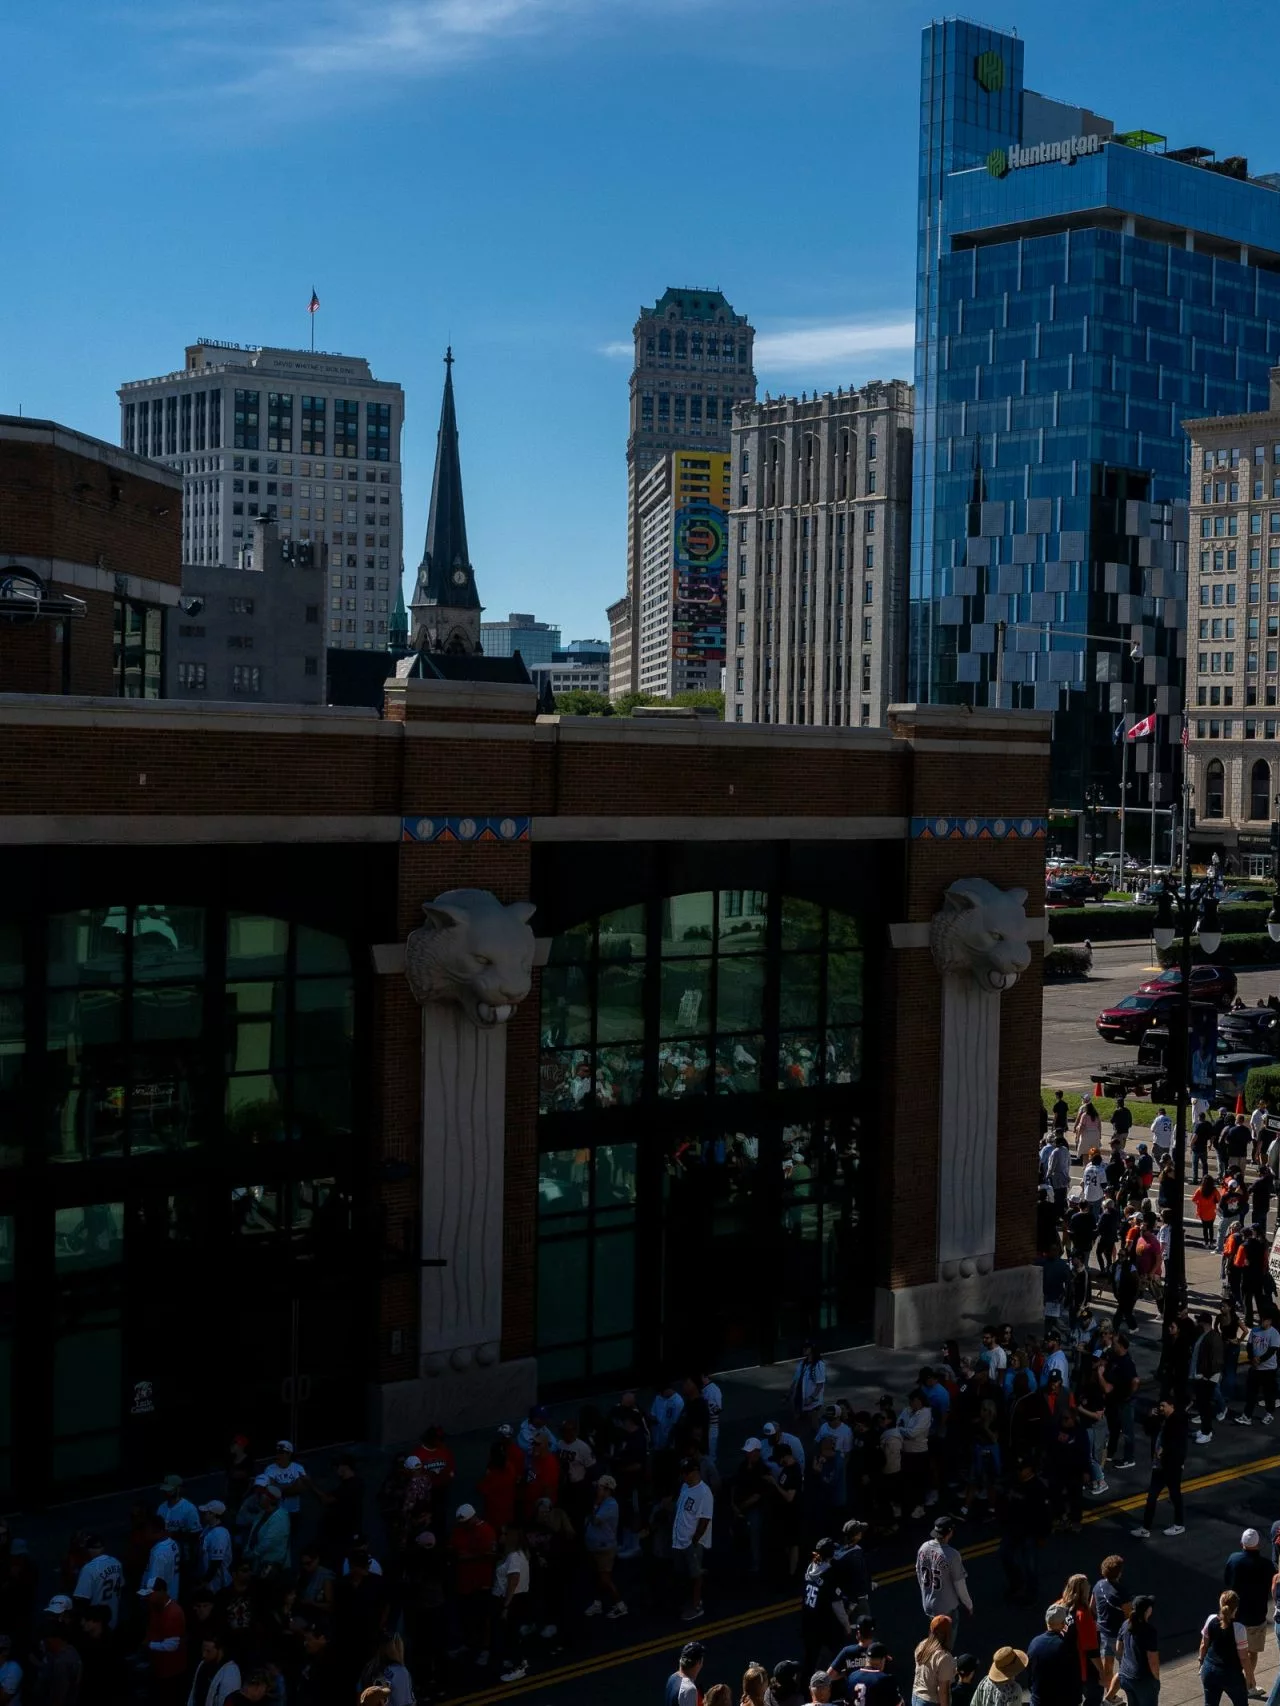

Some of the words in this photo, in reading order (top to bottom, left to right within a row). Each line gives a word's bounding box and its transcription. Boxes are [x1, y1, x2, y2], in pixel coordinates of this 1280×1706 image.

[1008, 134, 1099, 169] Huntington
[1086, 1174, 1097, 1186] 24
[854, 1683, 867, 1706] 3
